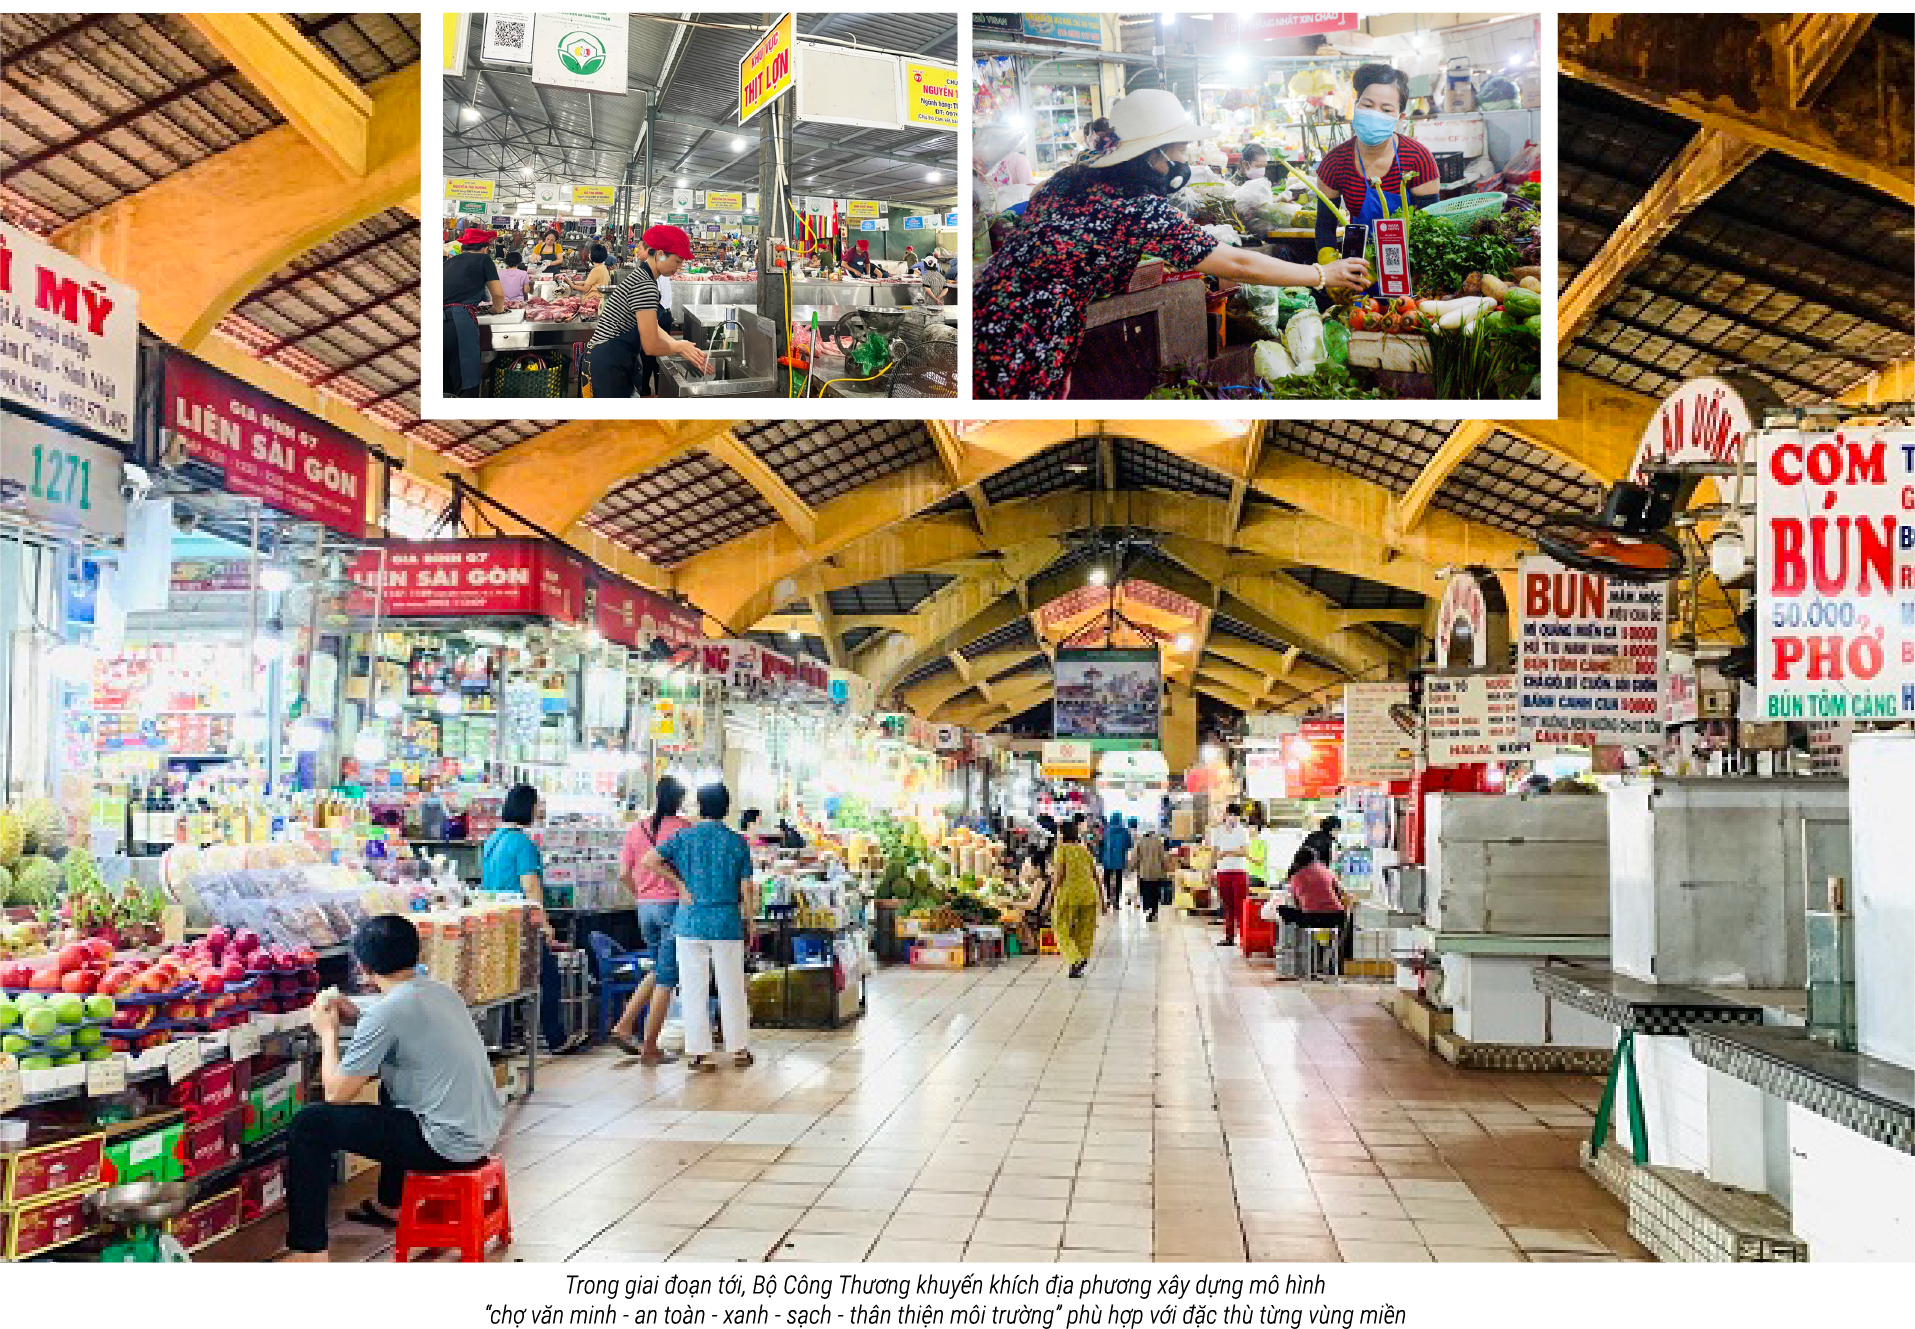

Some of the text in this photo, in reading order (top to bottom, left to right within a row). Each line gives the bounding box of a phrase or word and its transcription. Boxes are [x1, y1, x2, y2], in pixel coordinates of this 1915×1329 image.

[1299, 13, 1314, 23] XIN
[751, 31, 779, 70] KHU VỰC
[744, 47, 789, 107] THỊT LỢN
[923, 84, 954, 98] NGUYỄN
[35, 265, 113, 337] MỸ
[229, 399, 258, 423] GIA
[262, 406, 297, 439] ĐÌNH
[176, 397, 242, 451] LIÊN
[251, 430, 297, 473] SÀI
[303, 454, 358, 499] GÒN
[1770, 431, 1888, 486] CƠM
[31, 443, 92, 511] 1271
[392, 553, 419, 563] GIA
[1771, 490, 1898, 597] BÚN
[415, 566, 459, 587] SÀI
[466, 563, 531, 586] GÒN
[1771, 625, 1885, 681] PHỞ
[1768, 689, 1898, 717] BÚN TÔM CÀNG
